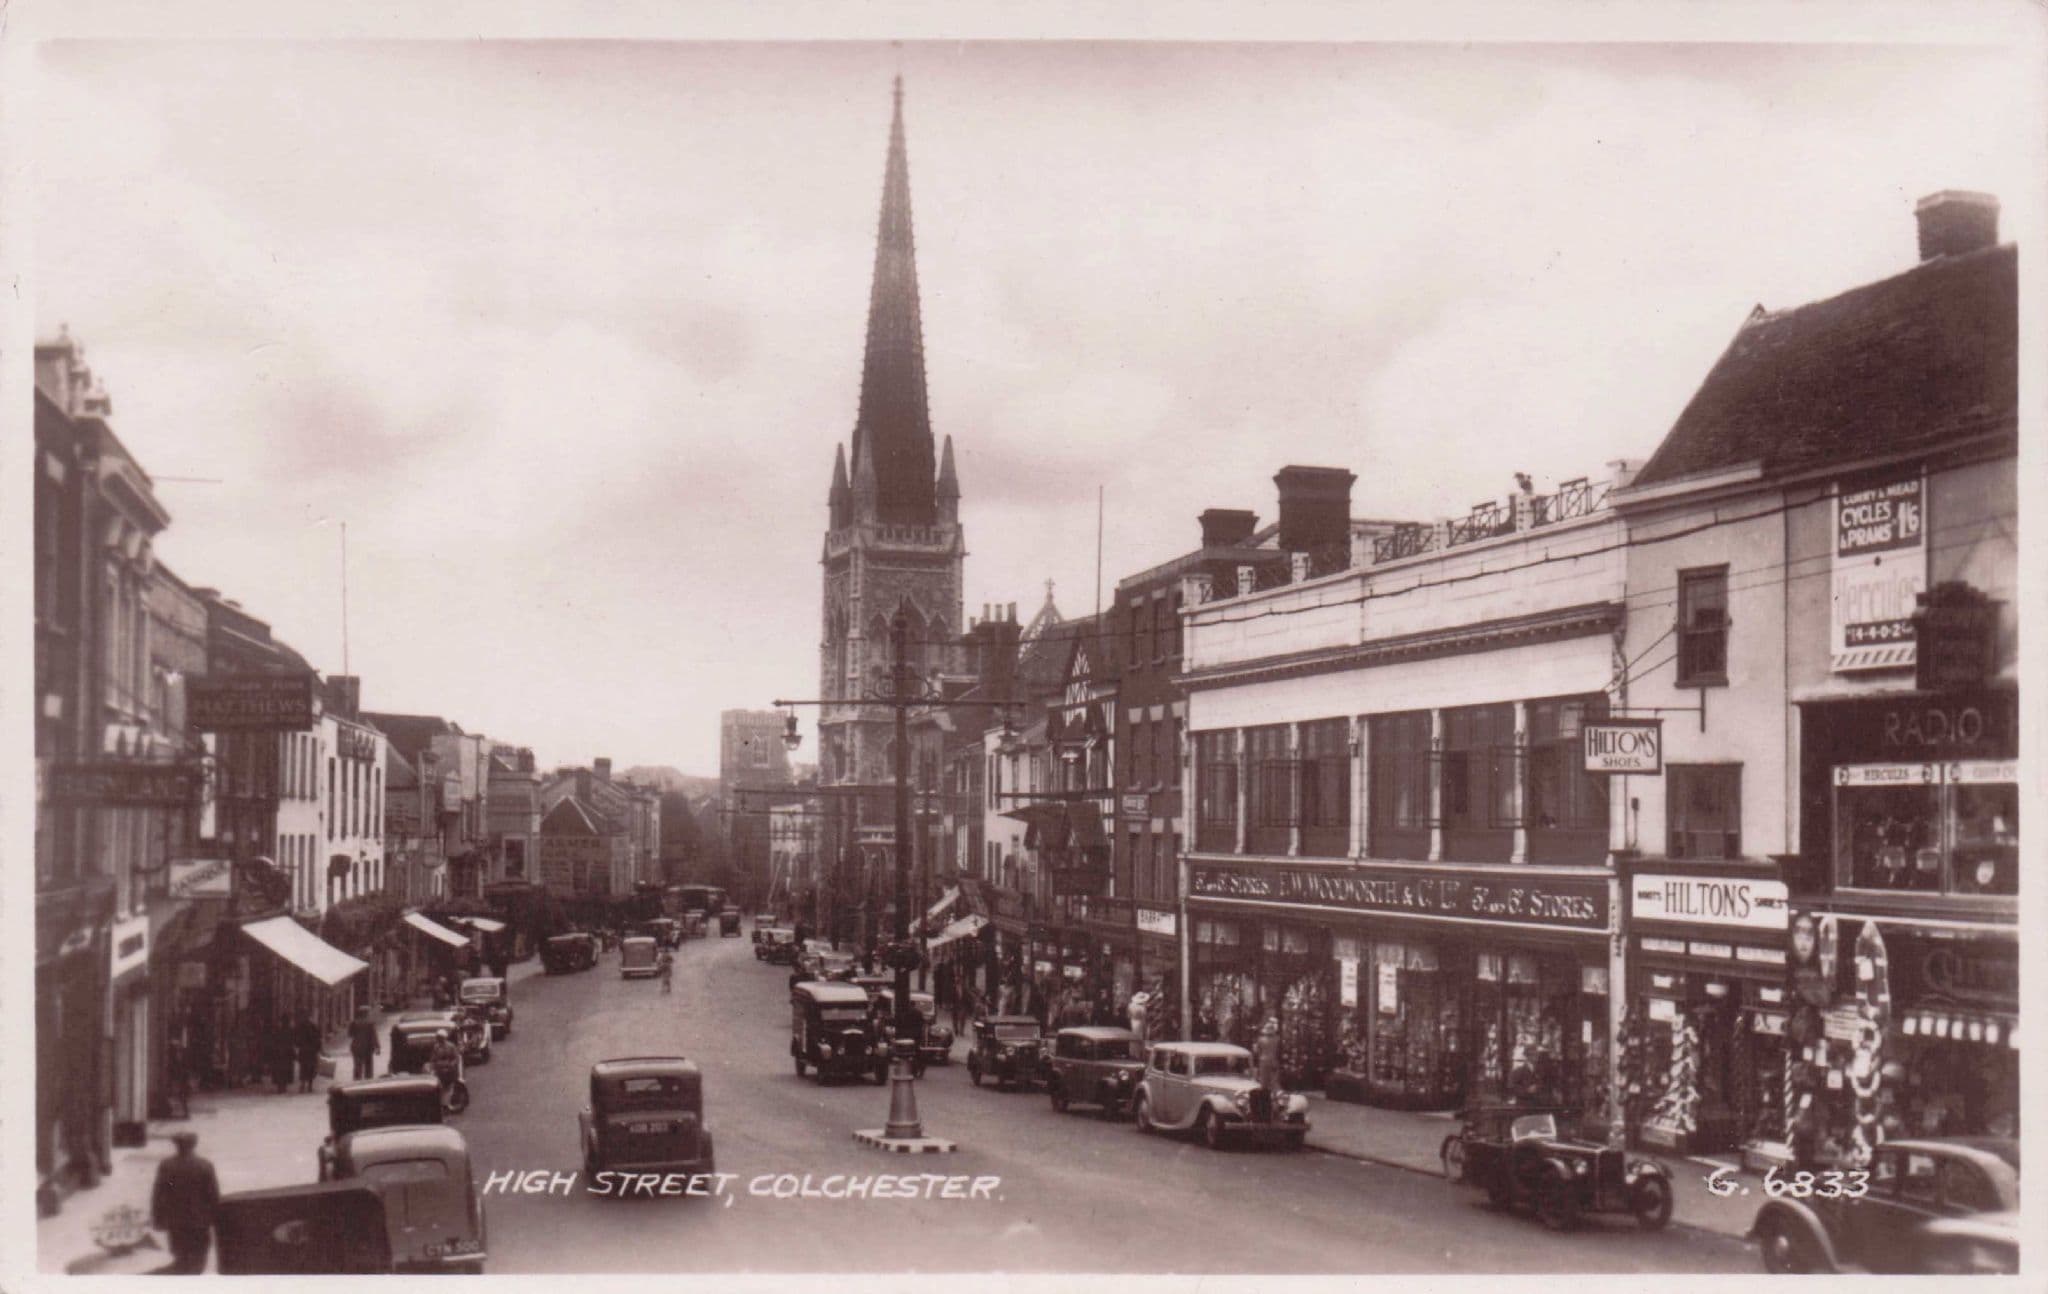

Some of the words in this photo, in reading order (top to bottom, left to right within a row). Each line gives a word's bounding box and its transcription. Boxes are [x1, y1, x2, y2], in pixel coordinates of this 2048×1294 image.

[1841, 500, 1892, 528] CYCLES
[1884, 706, 1983, 746] RADIO
[1588, 727, 1656, 758] HILTONS
[1602, 757, 1642, 768] SHOES
[1664, 881, 1751, 919] HILTONS
